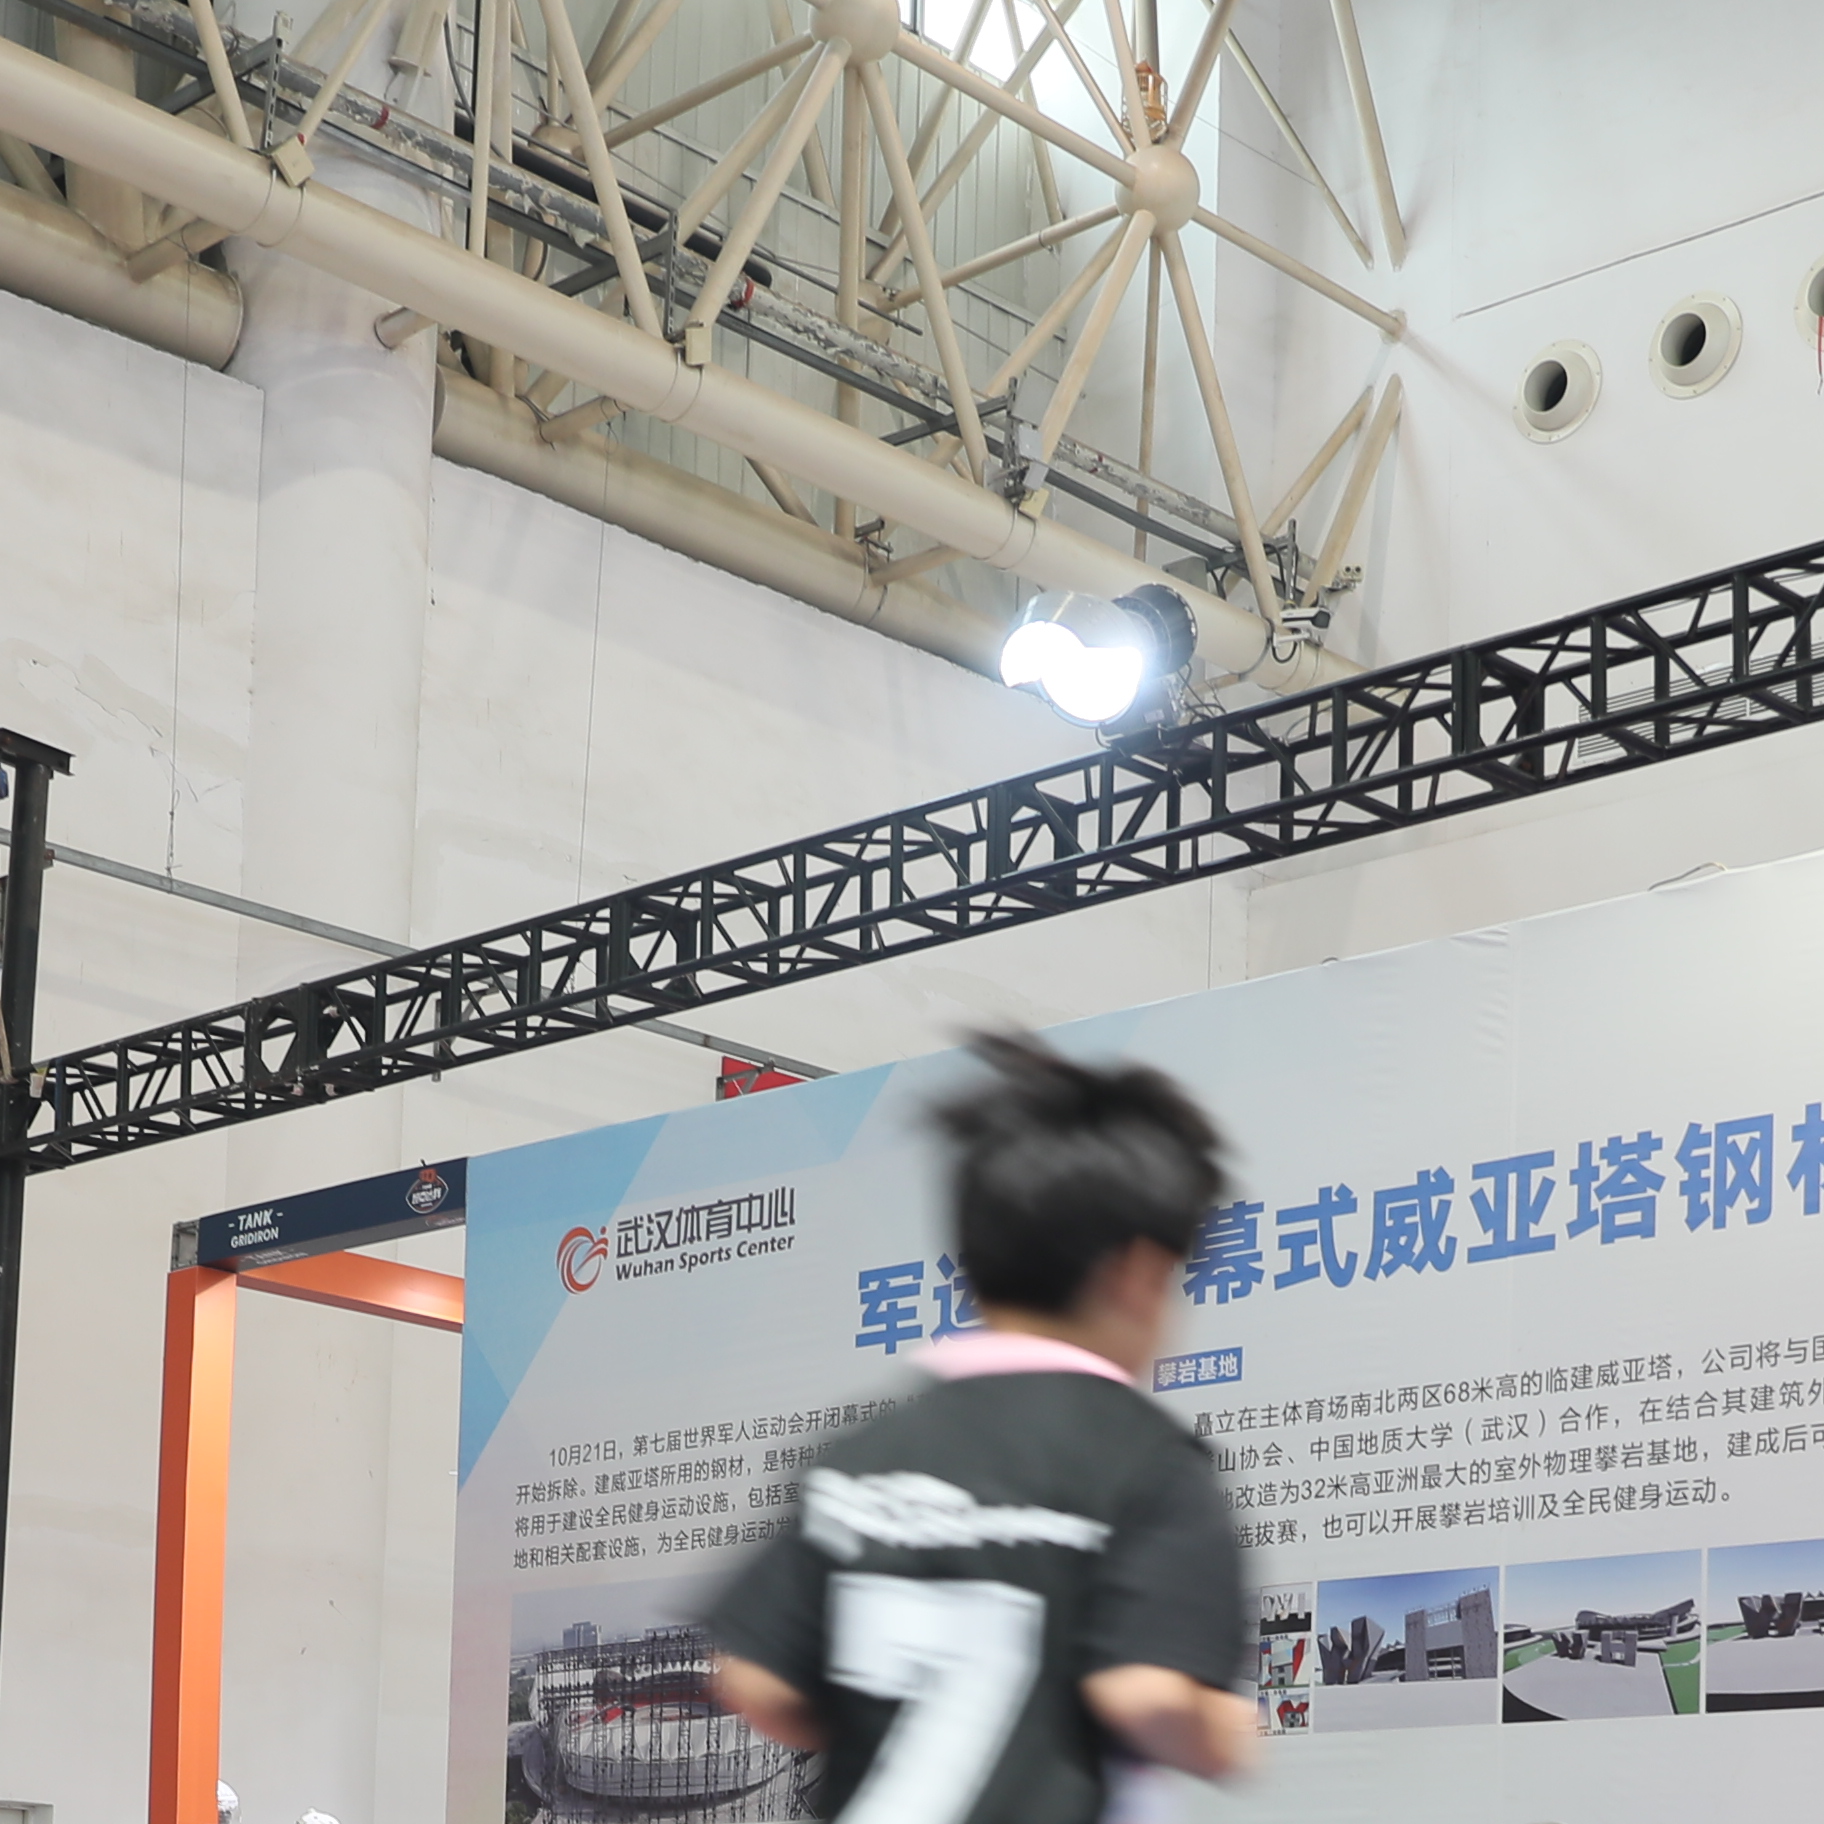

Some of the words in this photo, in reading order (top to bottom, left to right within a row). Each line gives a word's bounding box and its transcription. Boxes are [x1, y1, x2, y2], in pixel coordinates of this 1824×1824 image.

[237, 1208, 274, 1231] TANK
[616, 1187, 796, 1259] 武汉体育中心
[230, 1227, 279, 1249] GRIDIRON
[616, 1256, 675, 1281] Wuhan
[678, 1245, 732, 1273] Sports
[736, 1234, 796, 1259] Center
[1157, 1353, 1238, 1387] 攀岩基地
